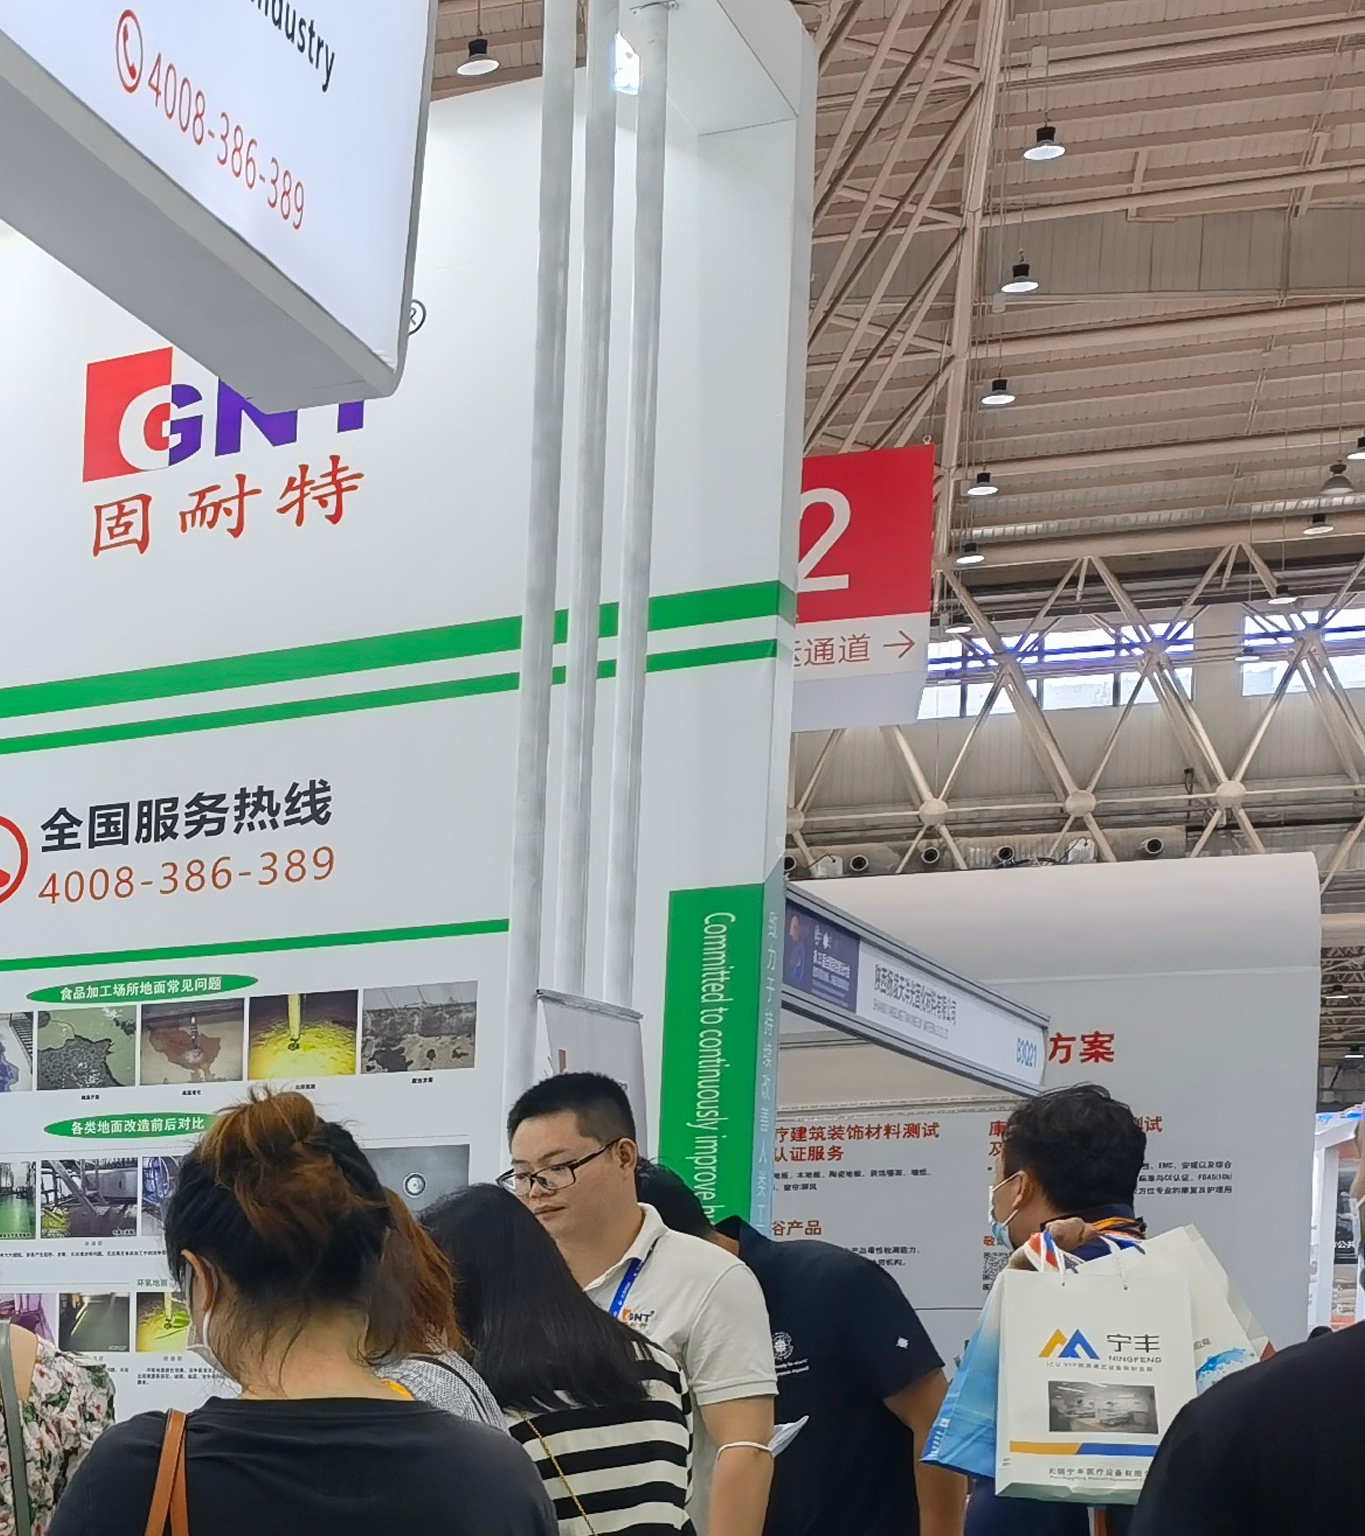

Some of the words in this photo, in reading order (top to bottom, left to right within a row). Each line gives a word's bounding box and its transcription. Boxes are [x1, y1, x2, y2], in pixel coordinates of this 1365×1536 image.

[251, 0, 335, 92] dustry
[147, 52, 306, 231] 4008-386-389
[92, 454, 365, 558] 固耐特
[797, 487, 851, 593] 2
[40, 779, 333, 854] 全国服务热线
[38, 846, 336, 905] 4008-386-389
[59, 976, 223, 1001] 食品加工场所地面常见问题
[700, 912, 736, 1003] Committed
[699, 1007, 729, 1025] to
[1048, 1030, 1115, 1064] 方案
[685, 1029, 731, 1131] continuously
[71, 1117, 205, 1136] 各类地面改造前后对比
[684, 1134, 728, 1201] improve
[1106, 1333, 1160, 1353] 宁丰
